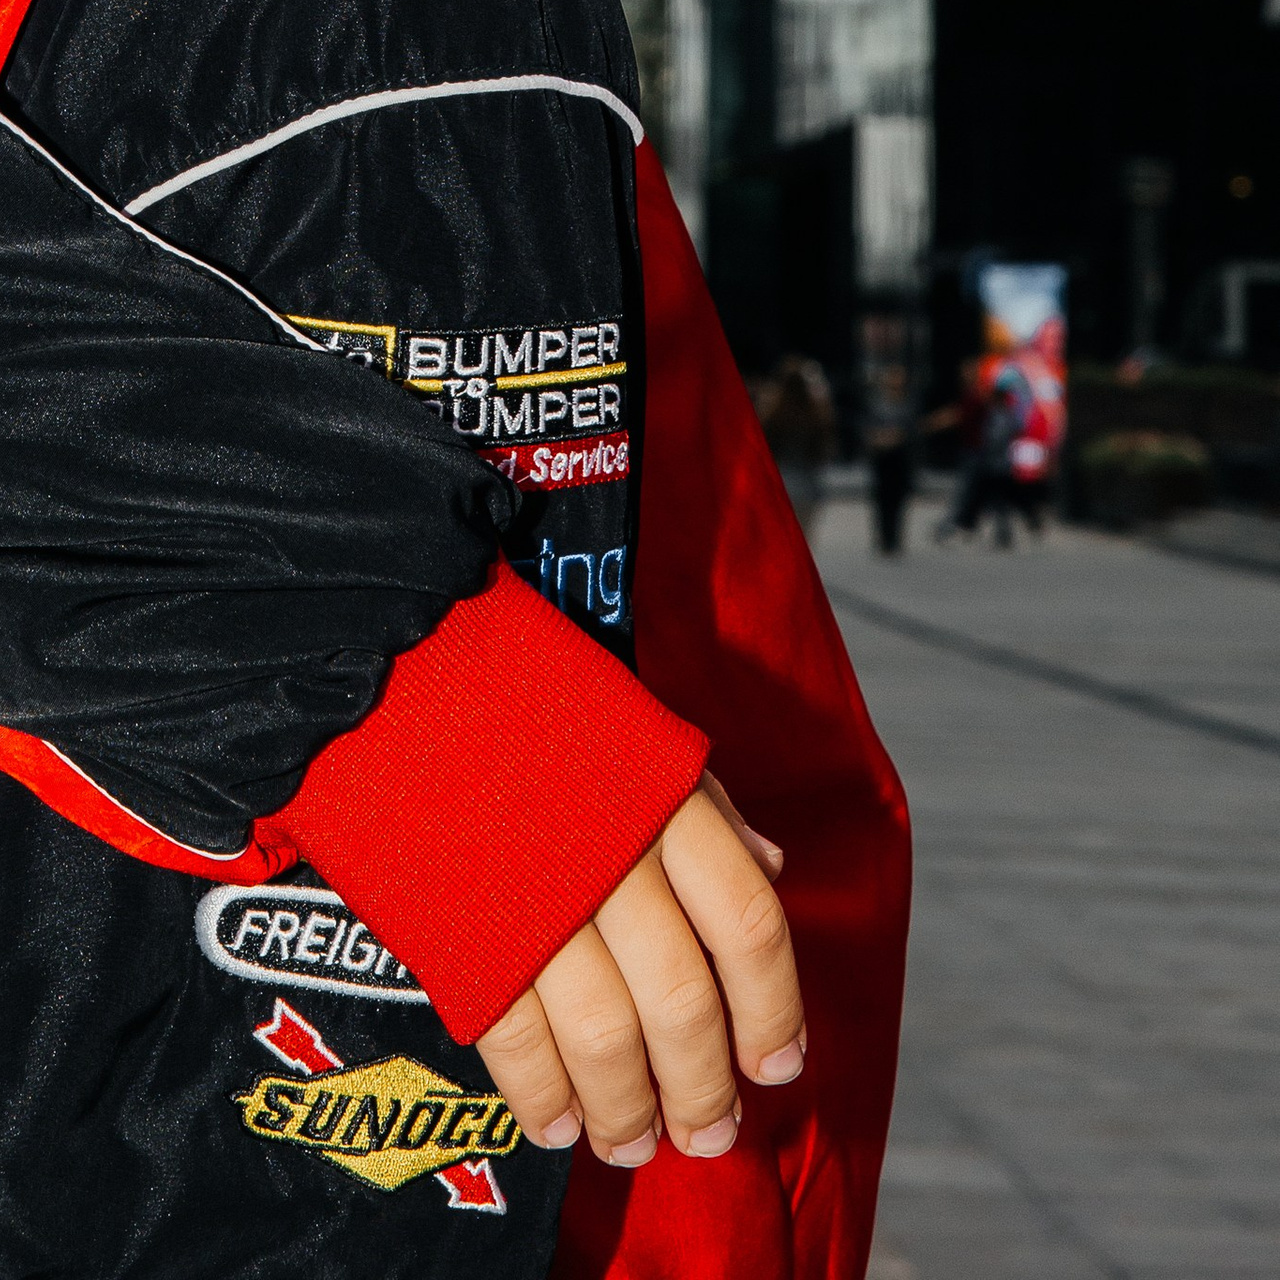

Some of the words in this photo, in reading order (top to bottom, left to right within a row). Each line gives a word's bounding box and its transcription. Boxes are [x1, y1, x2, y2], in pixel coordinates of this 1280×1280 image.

[408, 323, 620, 378] BUMPER
[530, 441, 628, 483] Service
[253, 1088, 519, 1150] SUNOCO
